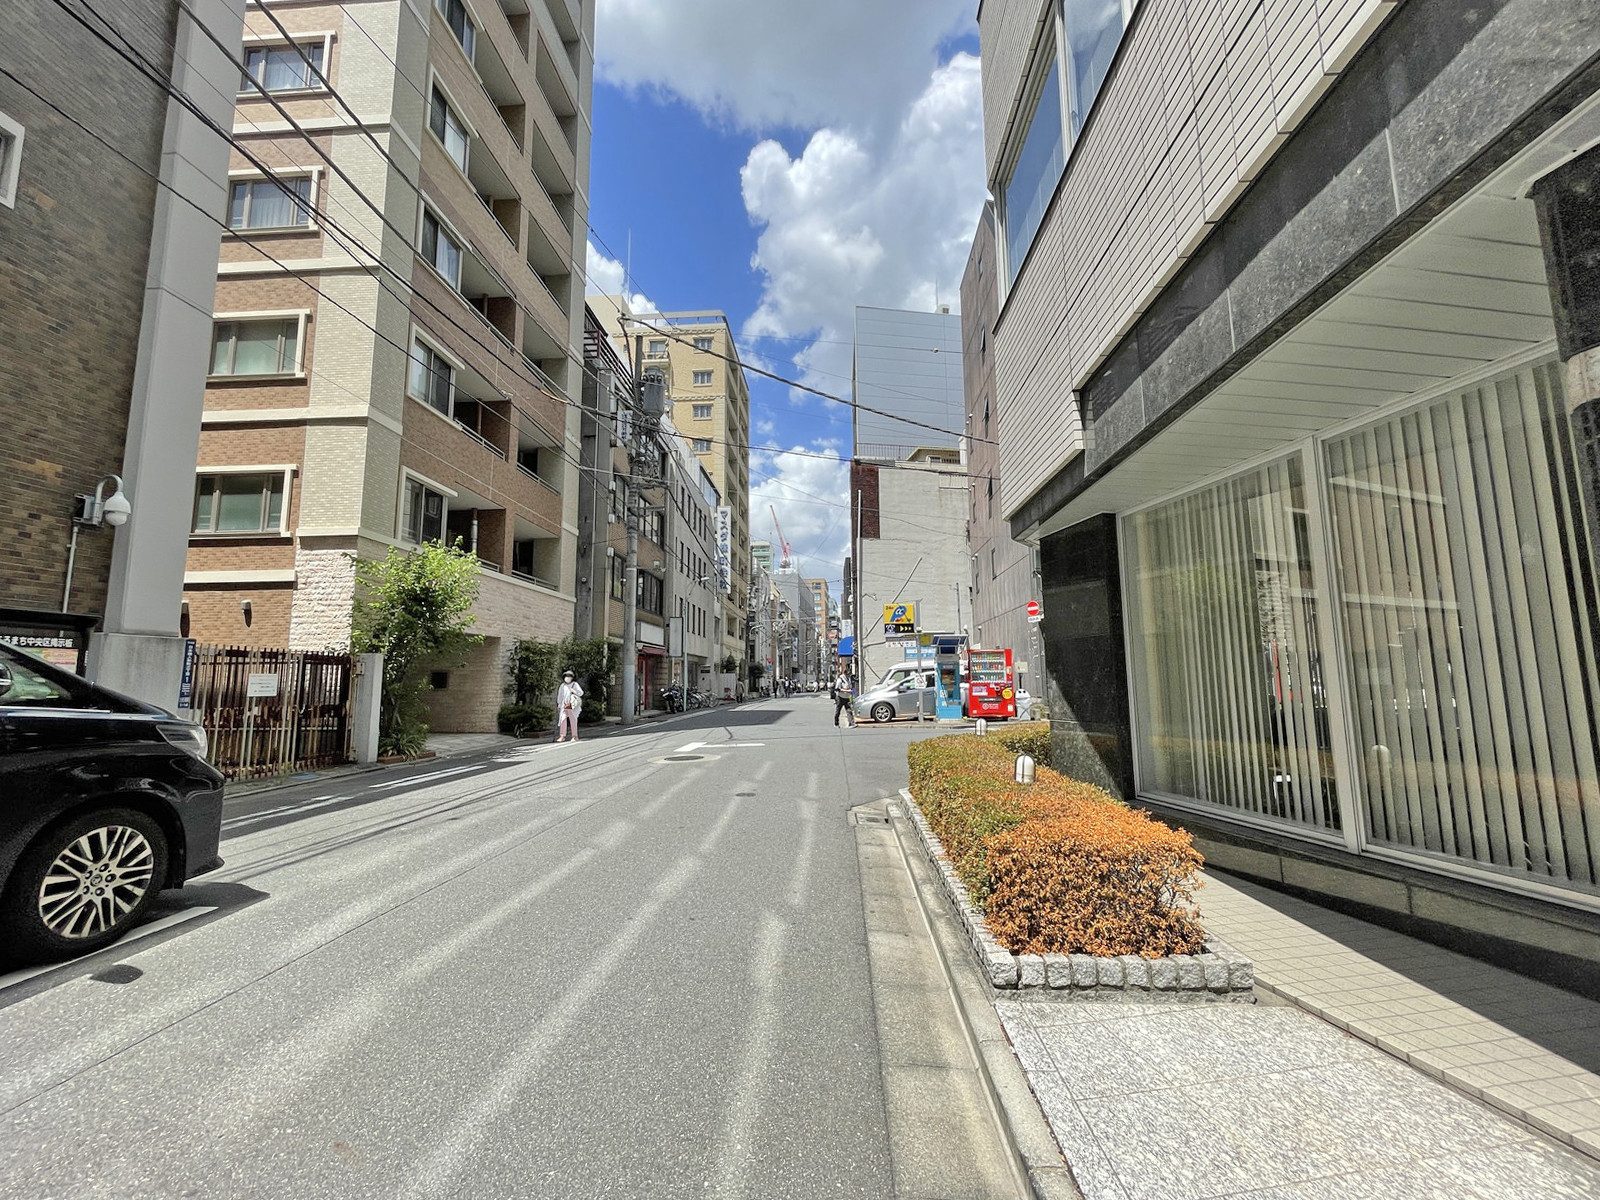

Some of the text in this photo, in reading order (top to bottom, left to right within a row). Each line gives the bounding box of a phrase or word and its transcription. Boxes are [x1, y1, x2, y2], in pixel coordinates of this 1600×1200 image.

[719, 510, 729, 590] マスダ株式会社
[0, 635, 74, 648] ろまち中央区掲示板
